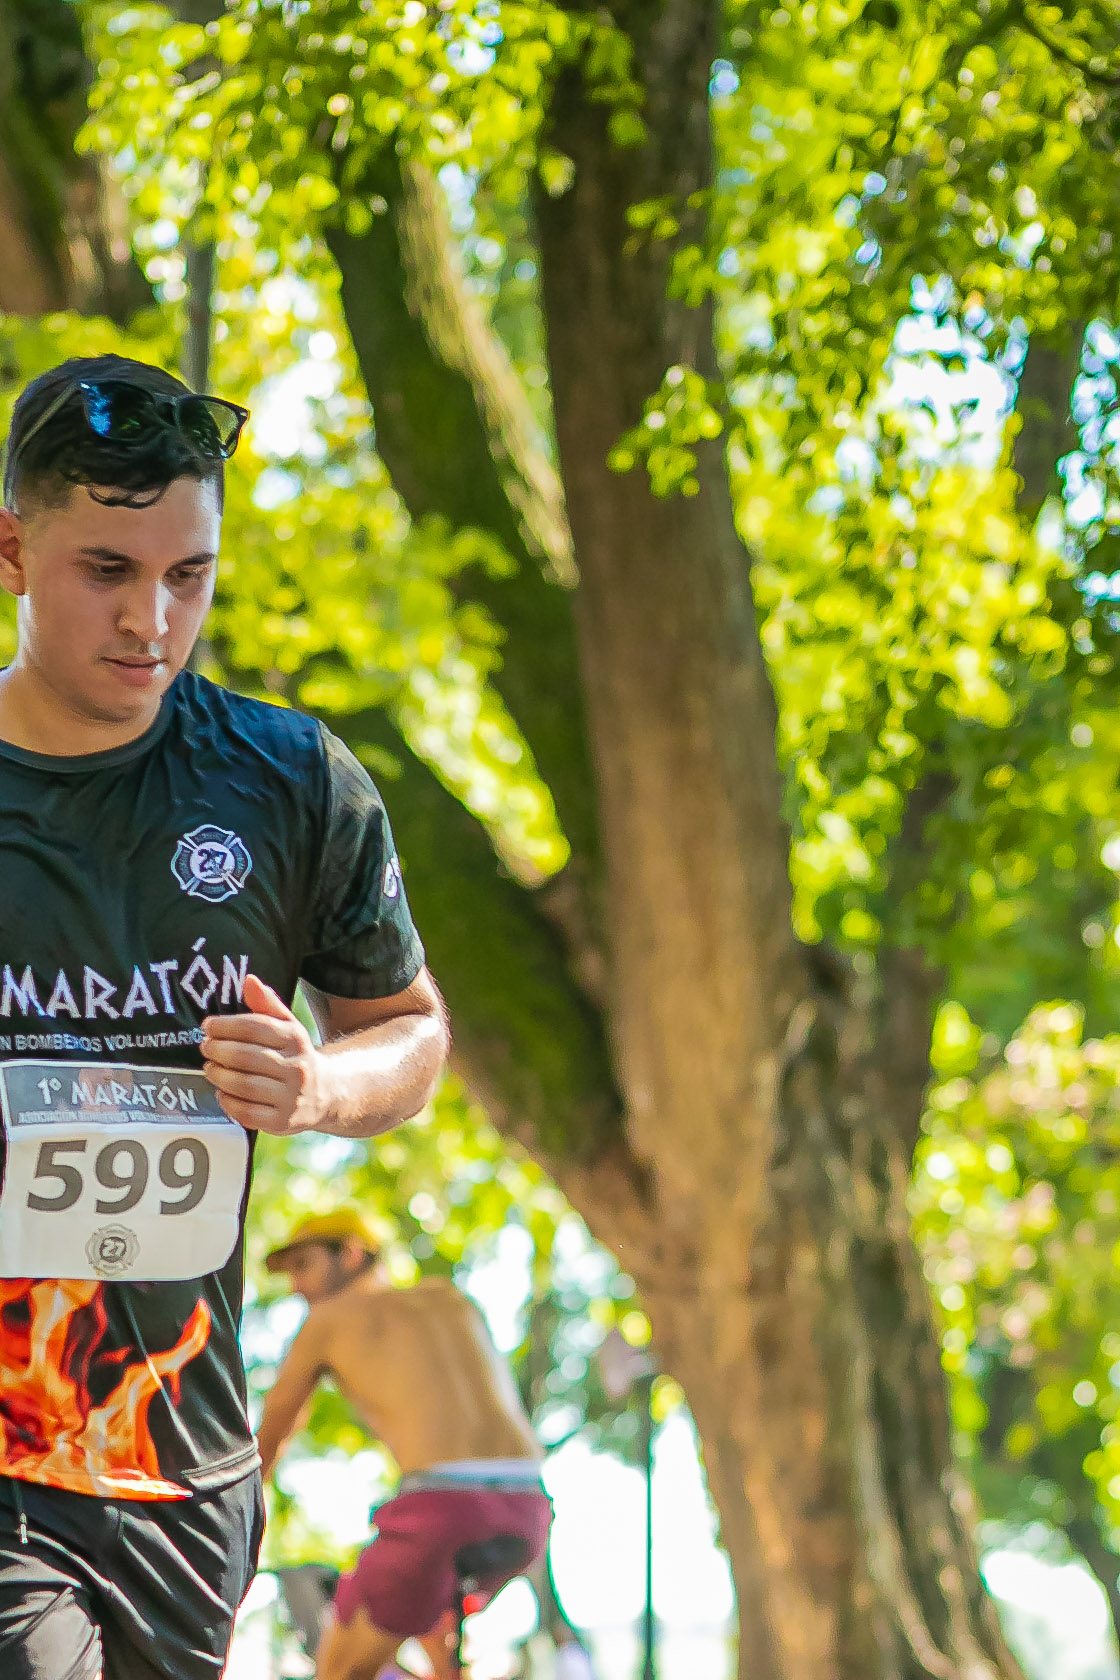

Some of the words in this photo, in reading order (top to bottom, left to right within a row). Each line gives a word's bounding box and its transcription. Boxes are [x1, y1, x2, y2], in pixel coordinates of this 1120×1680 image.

[198, 848, 227, 872] 27
[0, 937, 248, 1019] MARATÓN
[104, 1027, 204, 1051] VOLUNTARIO
[71, 1078, 199, 1111] MARATÓN
[27, 1138, 210, 1214] 599
[102, 1238, 125, 1257] 27
